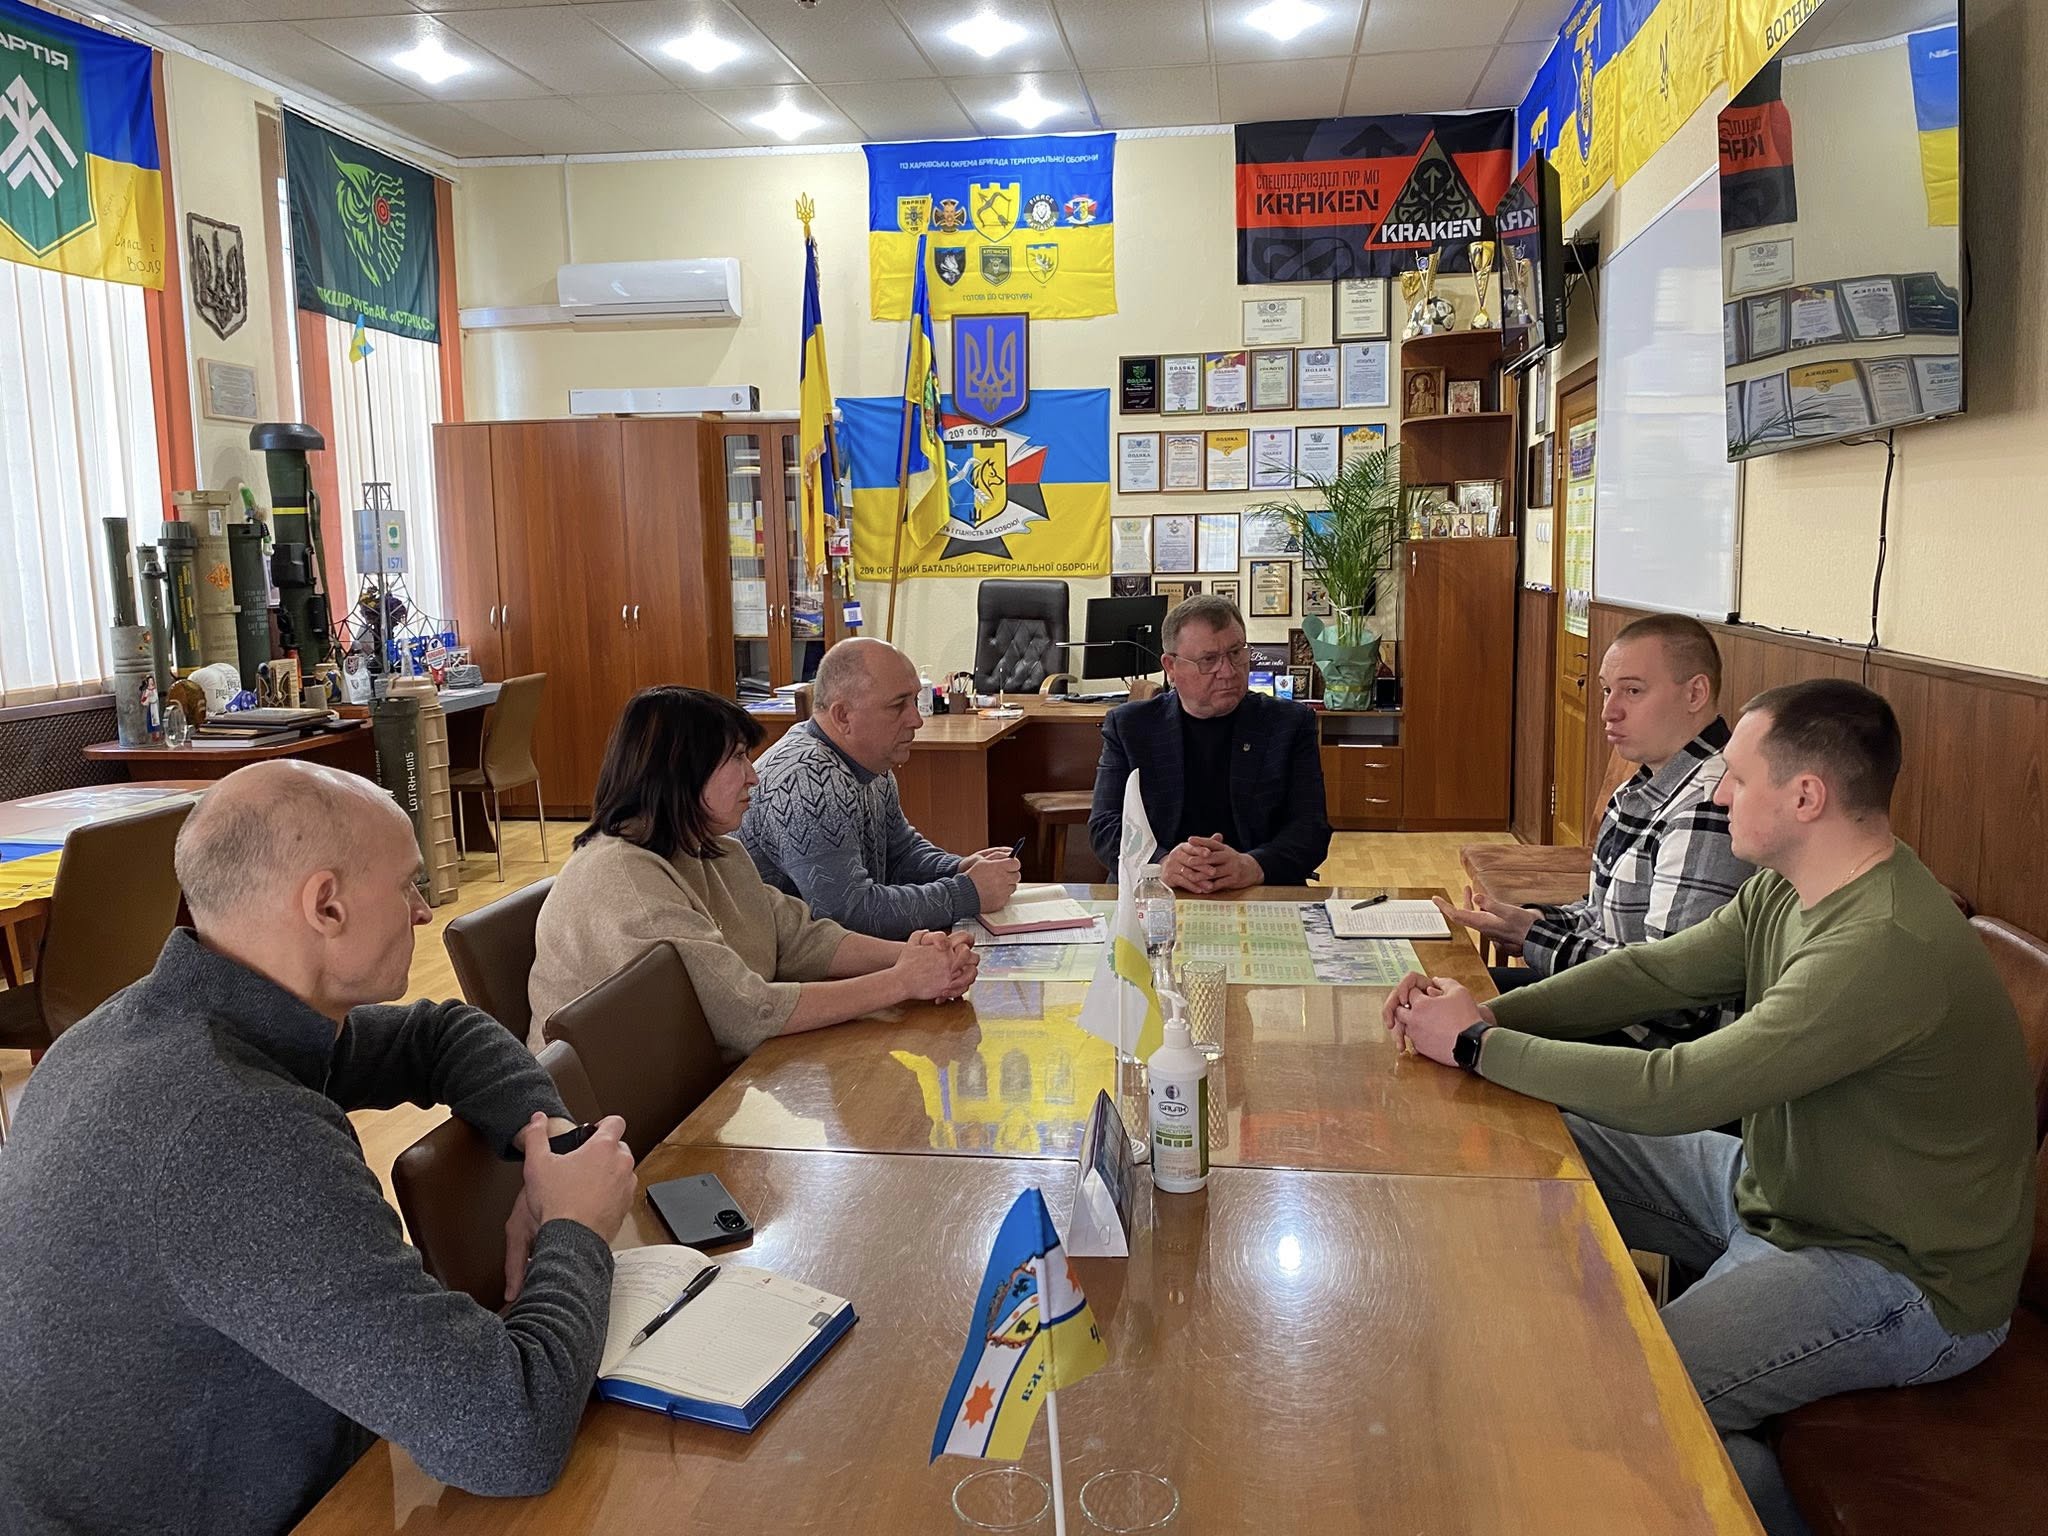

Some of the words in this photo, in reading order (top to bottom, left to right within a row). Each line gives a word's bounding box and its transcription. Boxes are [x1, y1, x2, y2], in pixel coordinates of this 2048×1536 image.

[1765, 0, 1824, 51] ВОГНЕ
[909, 160, 950, 170] ХАРКІВСЬКА
[951, 160, 978, 168] ОКРЕМА
[978, 158, 1009, 166] БРИГАДА
[1010, 155, 1065, 166] ТЕРИТОРІАЛЬНОЇ
[1066, 154, 1099, 164] ОБОРОНИ
[1256, 171, 1340, 191] СПЕЦПІДРОЗДІЛ
[1342, 170, 1360, 187] ГУР
[1363, 169, 1380, 186] МО
[1256, 189, 1380, 216] KRAKEN
[1382, 217, 1482, 243] KRAKEN
[948, 429, 965, 440] 209
[968, 427, 979, 436] об
[980, 426, 998, 439] ТрО
[387, 556, 404, 569] 1571
[860, 566, 875, 576] 209
[876, 562, 919, 575] ОКРМИЙ
[922, 562, 975, 573] БАТАЛЬЙОН
[976, 562, 1054, 573] ТЕРИТОРІАЛЬНОЇ
[1056, 562, 1100, 572] ОБОРОНИ
[404, 751, 417, 792] RH-1015
[407, 793, 418, 812] LOT
